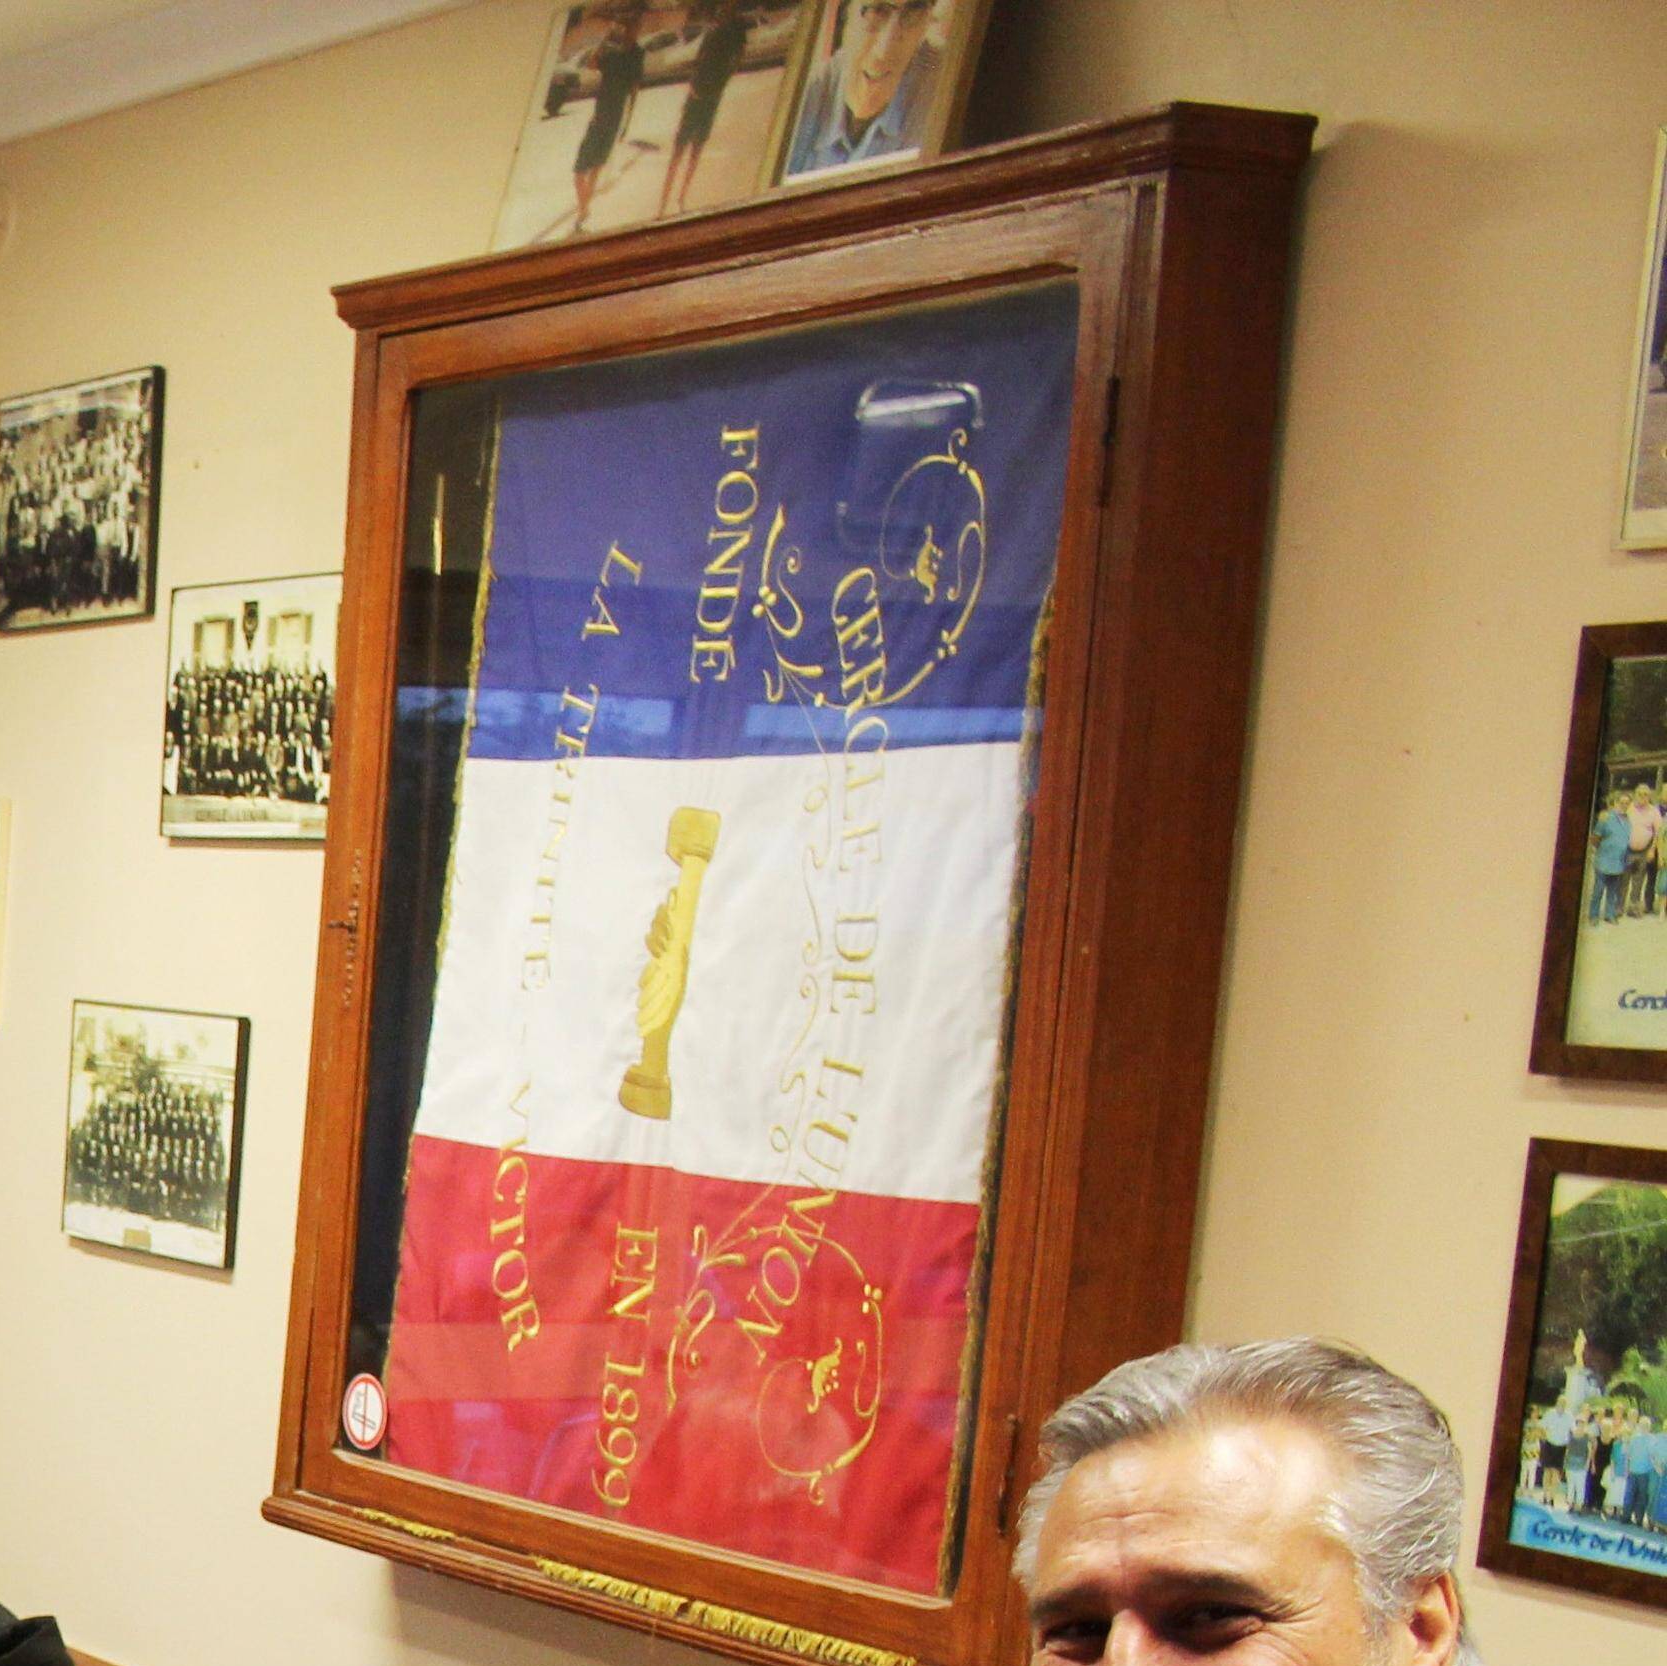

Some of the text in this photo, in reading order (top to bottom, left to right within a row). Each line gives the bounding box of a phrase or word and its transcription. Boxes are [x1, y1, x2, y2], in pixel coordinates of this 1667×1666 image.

[581, 538, 643, 642] LA
[489, 1078, 541, 1354] VICTOR
[590, 421, 761, 1508] FONDE EN 1899
[735, 567, 889, 1368] CERCLE DE L'UNION
